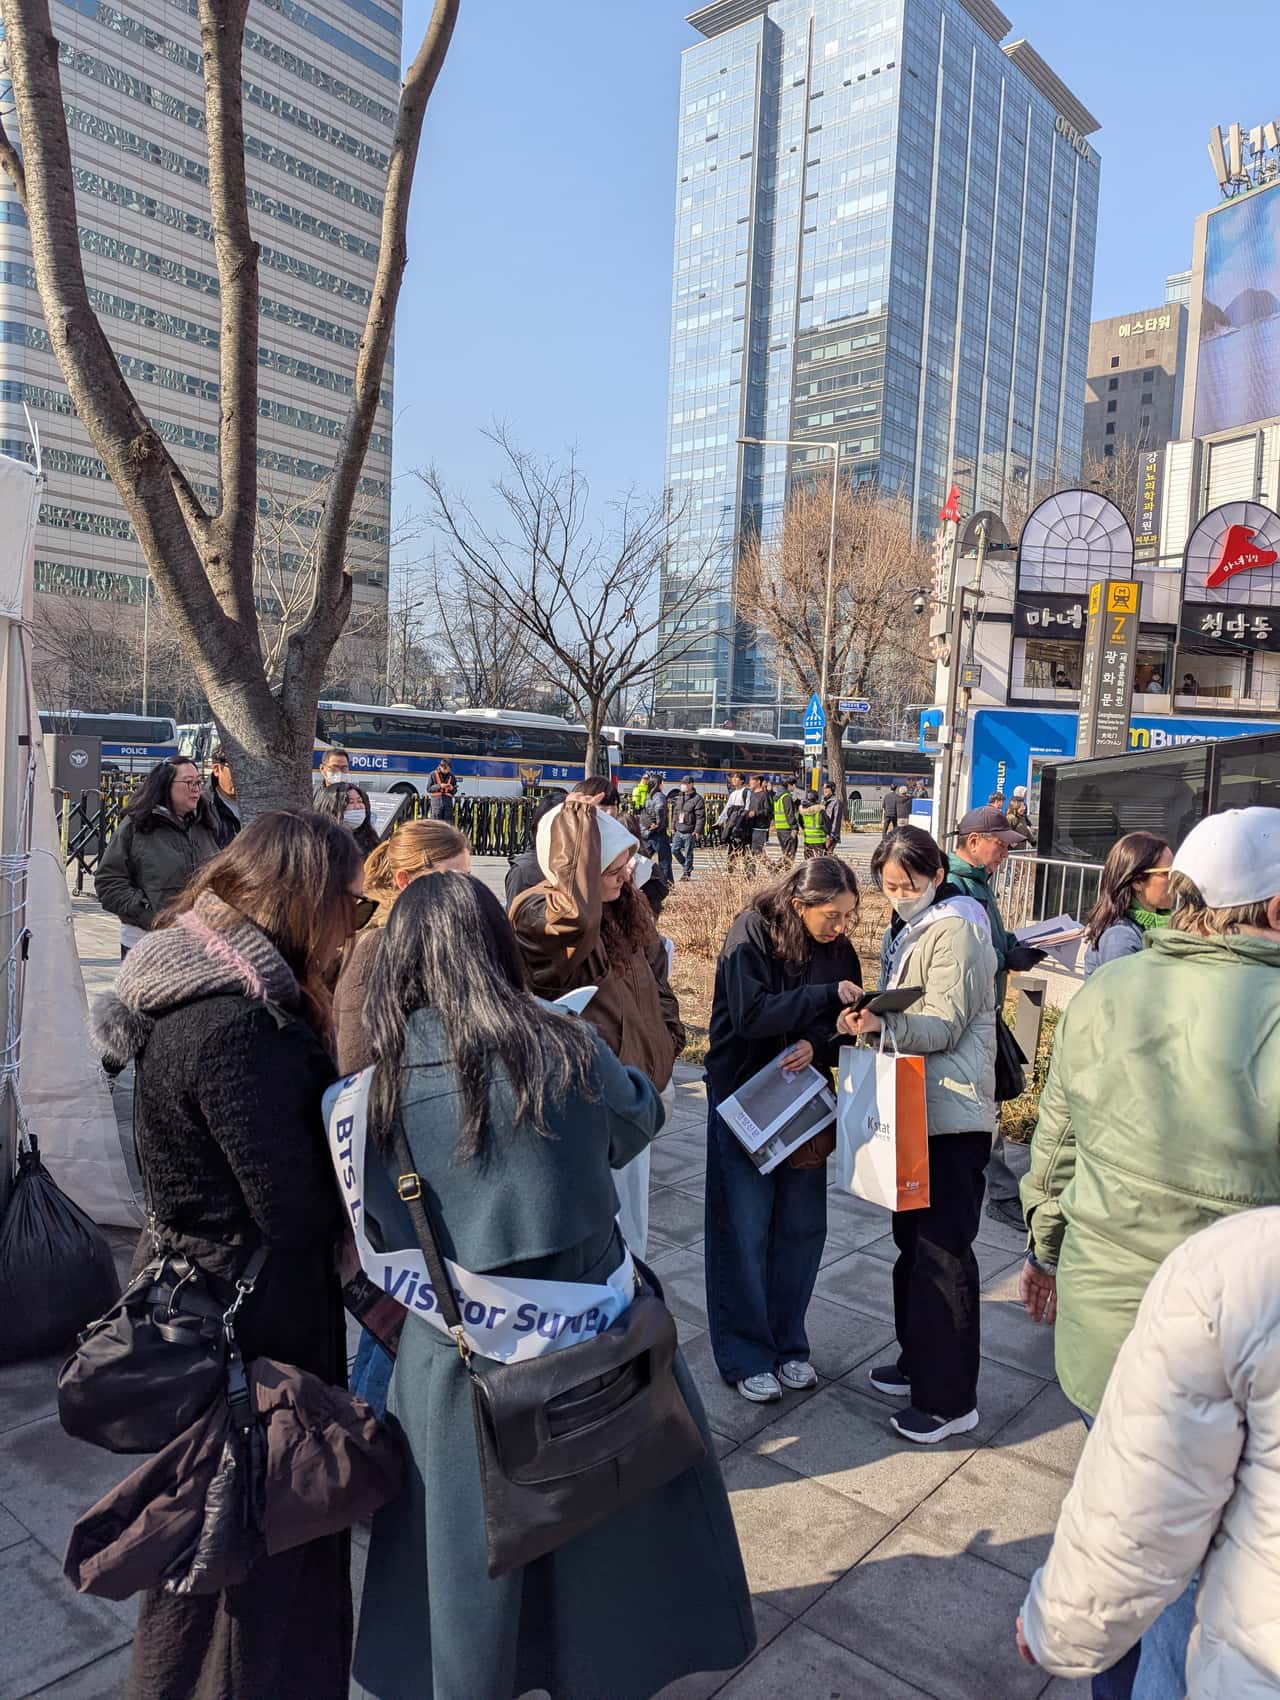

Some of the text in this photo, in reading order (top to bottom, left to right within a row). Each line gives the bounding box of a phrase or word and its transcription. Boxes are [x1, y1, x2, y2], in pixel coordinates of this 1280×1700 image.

[1118, 315, 1170, 337] 에스타워
[1026, 604, 1088, 629] 마녀
[1112, 616, 1127, 633] 7
[1201, 612, 1273, 639] 청담동
[1101, 651, 1118, 707] 광화문
[121, 747, 148, 755] POLICE
[352, 756, 388, 769] POLICE
[997, 760, 1006, 794] umBur
[336, 1115, 356, 1190] BTS
[350, 1198, 361, 1224] L
[383, 1266, 506, 1329] Visor
